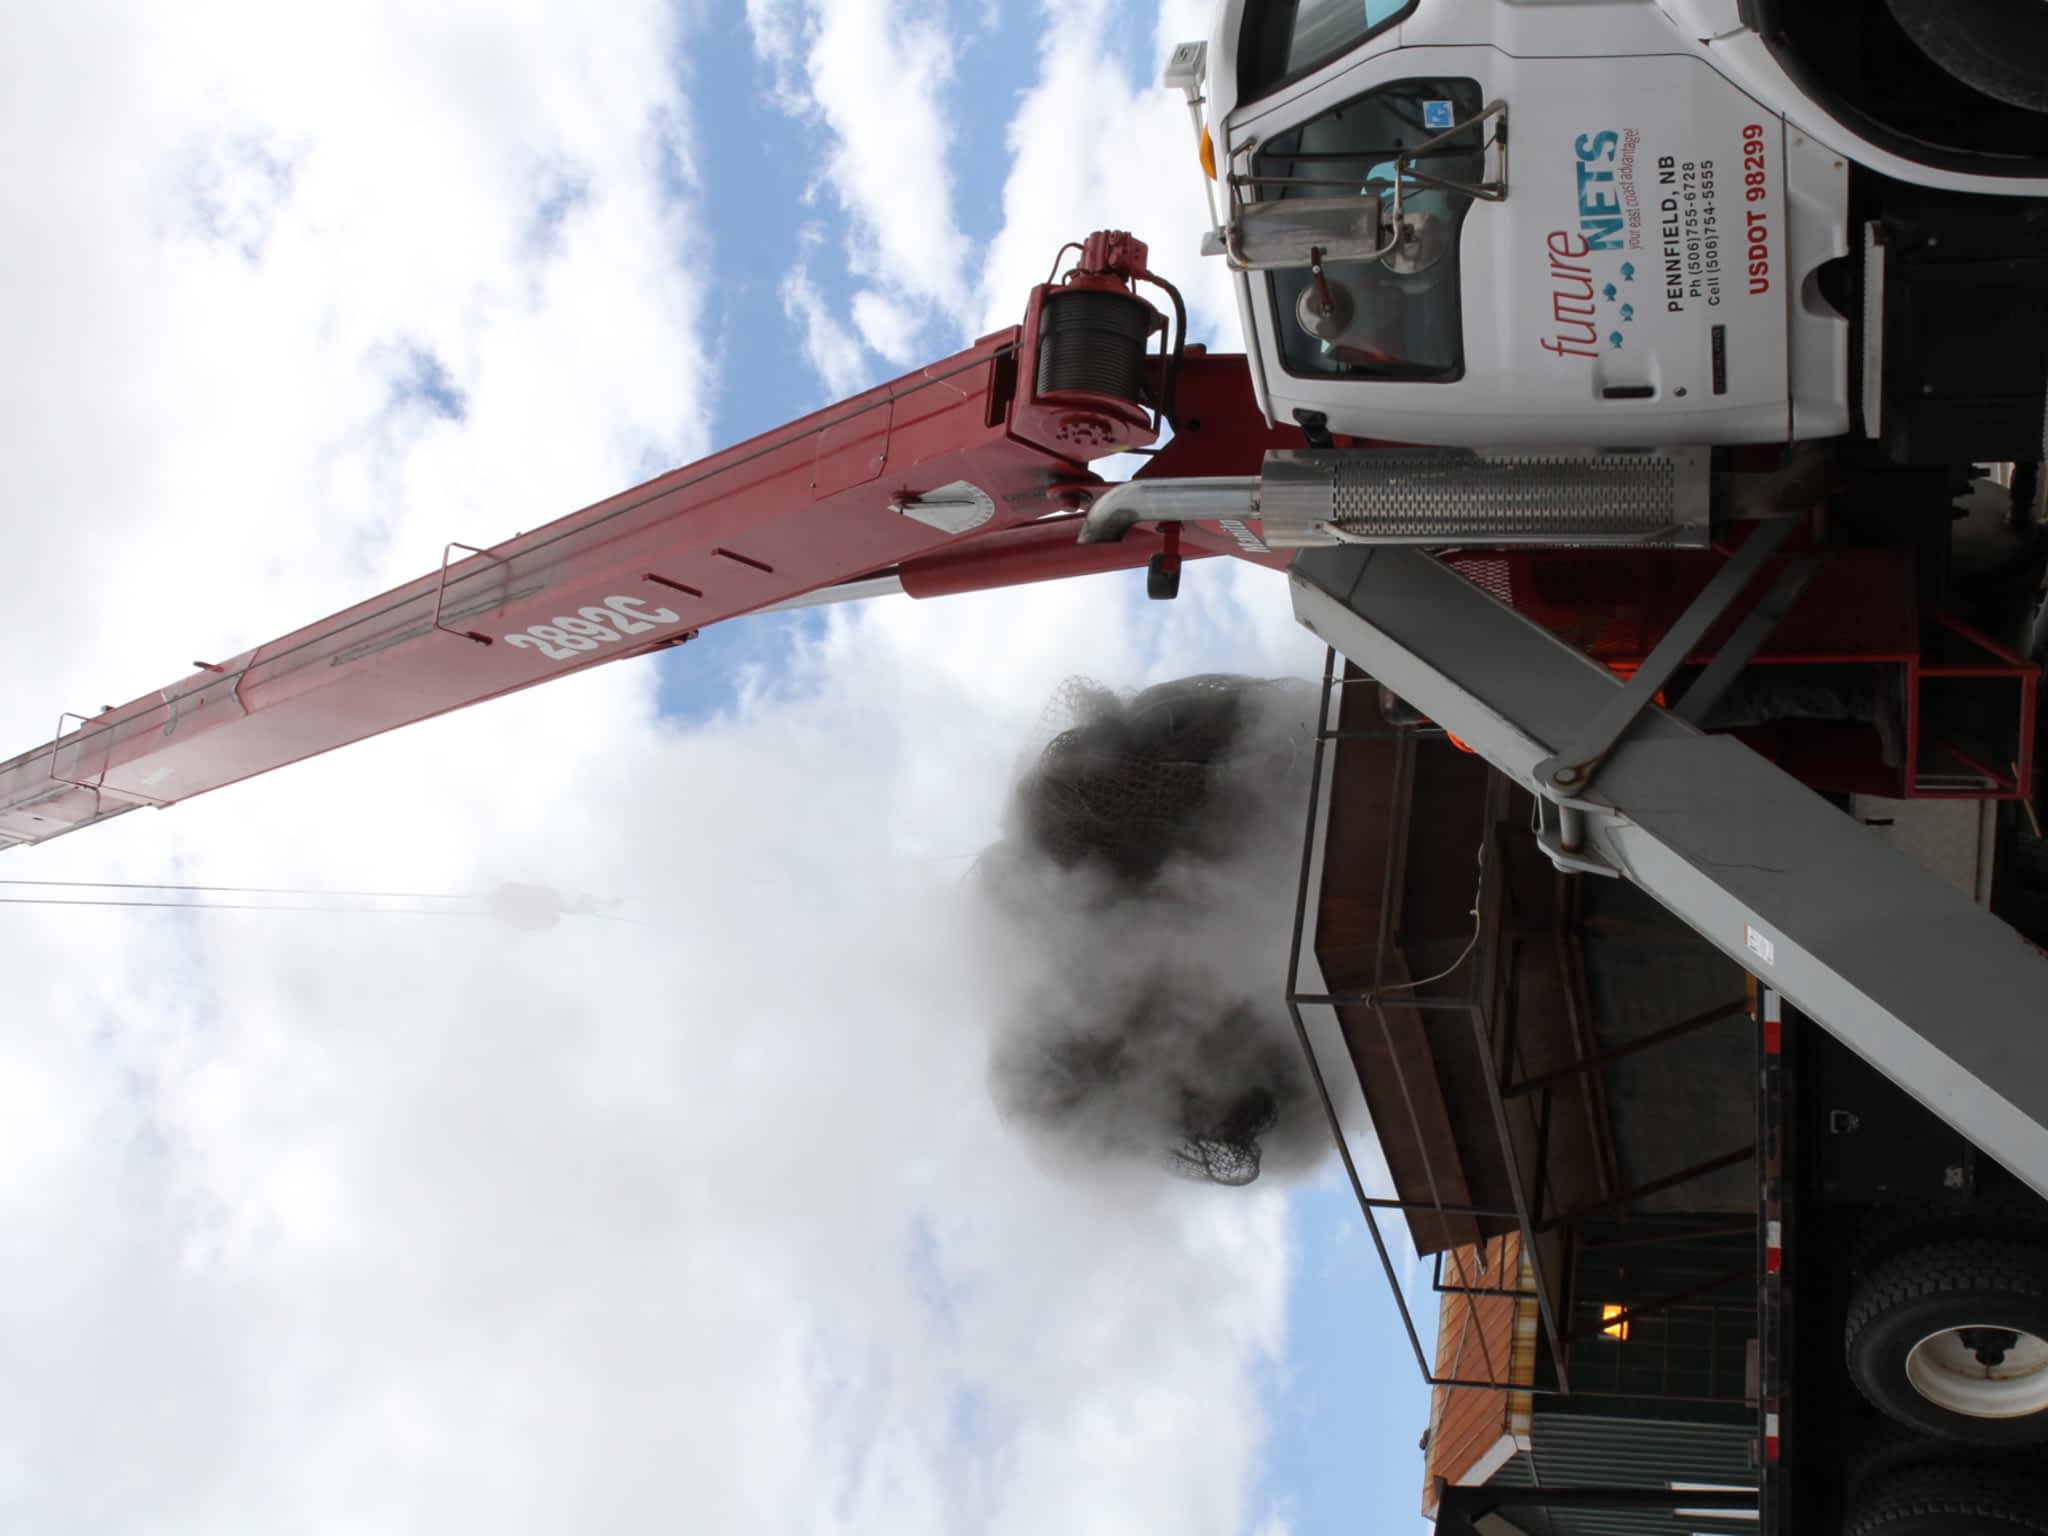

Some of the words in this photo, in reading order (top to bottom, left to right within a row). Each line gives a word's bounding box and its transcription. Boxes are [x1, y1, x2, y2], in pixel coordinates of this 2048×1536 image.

[1574, 130, 1624, 251] NETS
[1620, 181, 1639, 207] coast
[1658, 155, 1677, 184] NB
[1742, 124, 1766, 202] 98299
[1625, 209, 1641, 228] east
[1628, 231, 1642, 250] your
[1661, 191, 1684, 312] PENNFIELD,
[1682, 161, 1703, 275] (506)755-6728
[1701, 160, 1720, 274] (506)754-5555
[1747, 210, 1769, 294] USDOT
[1540, 231, 1599, 358] future
[1689, 279, 1702, 297] Ph
[1706, 277, 1720, 306] Cell
[504, 595, 681, 661] 2892C
